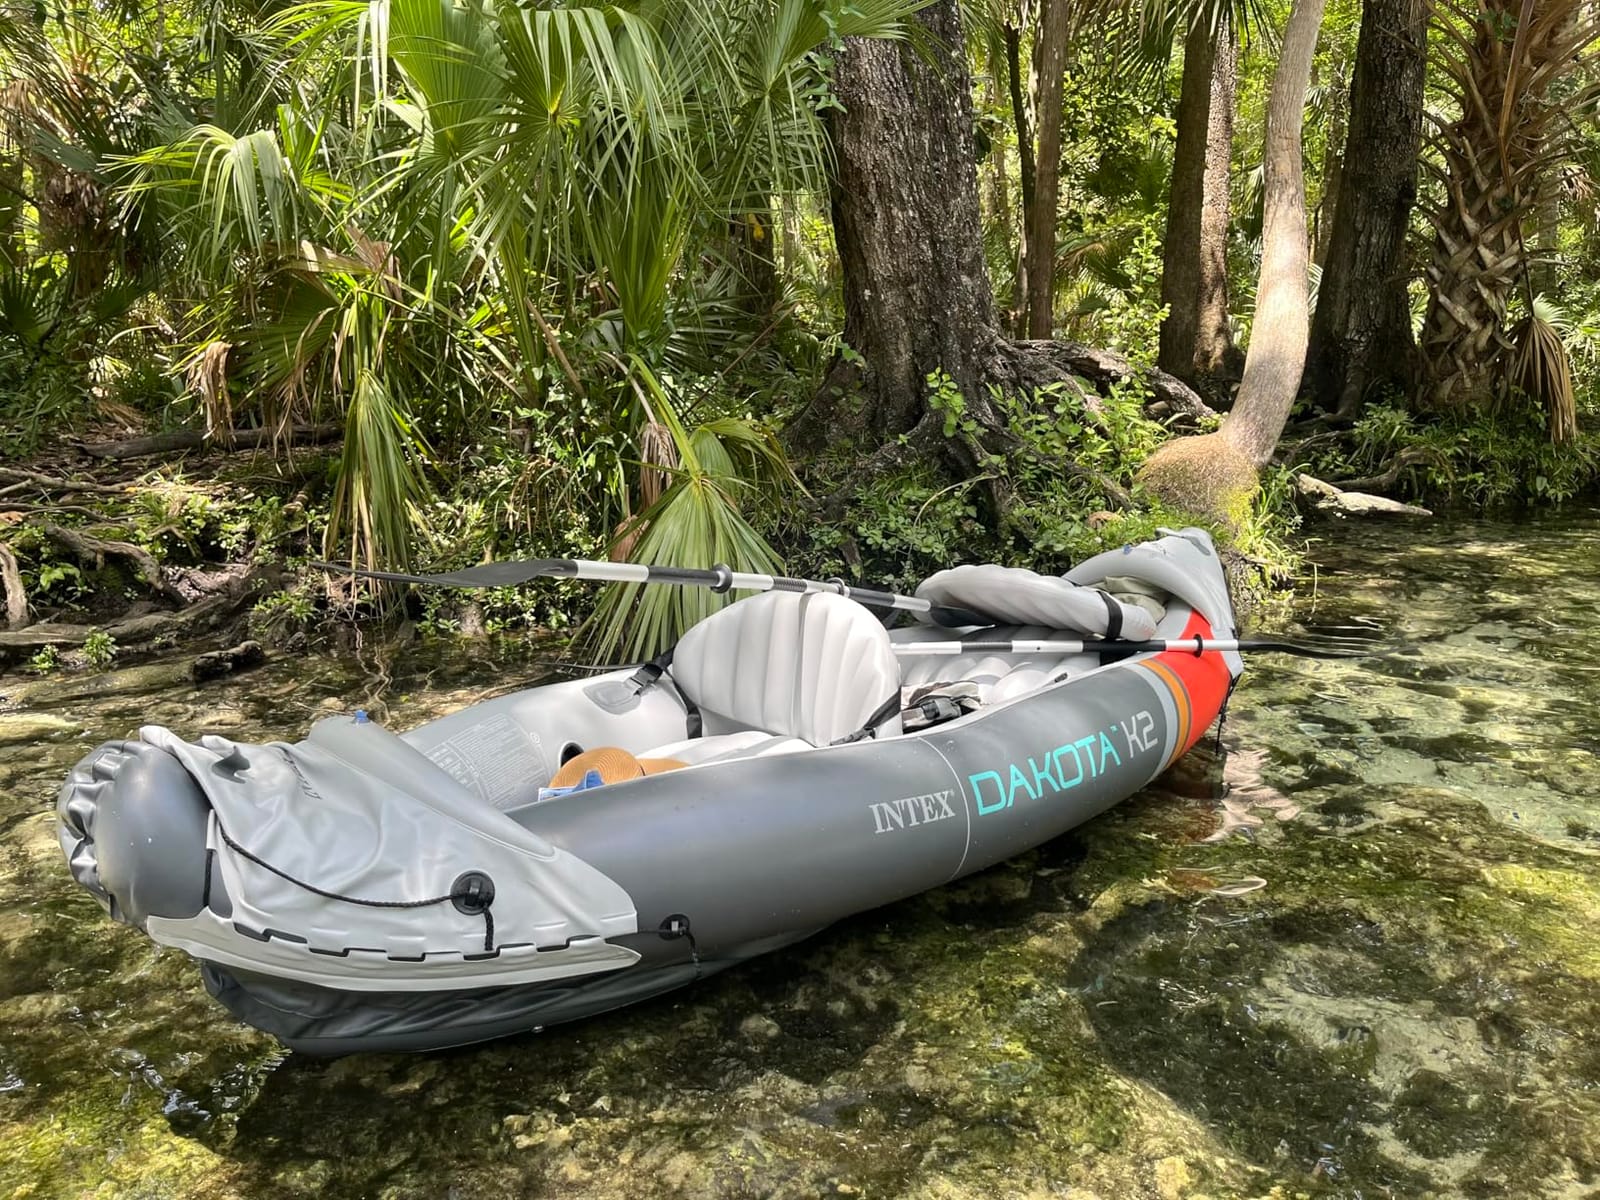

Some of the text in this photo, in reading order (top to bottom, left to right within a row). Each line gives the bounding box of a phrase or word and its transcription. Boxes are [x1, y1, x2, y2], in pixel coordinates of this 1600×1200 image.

[968, 710, 1158, 816] DAKOTA K2
[868, 789, 956, 834] INTEX
